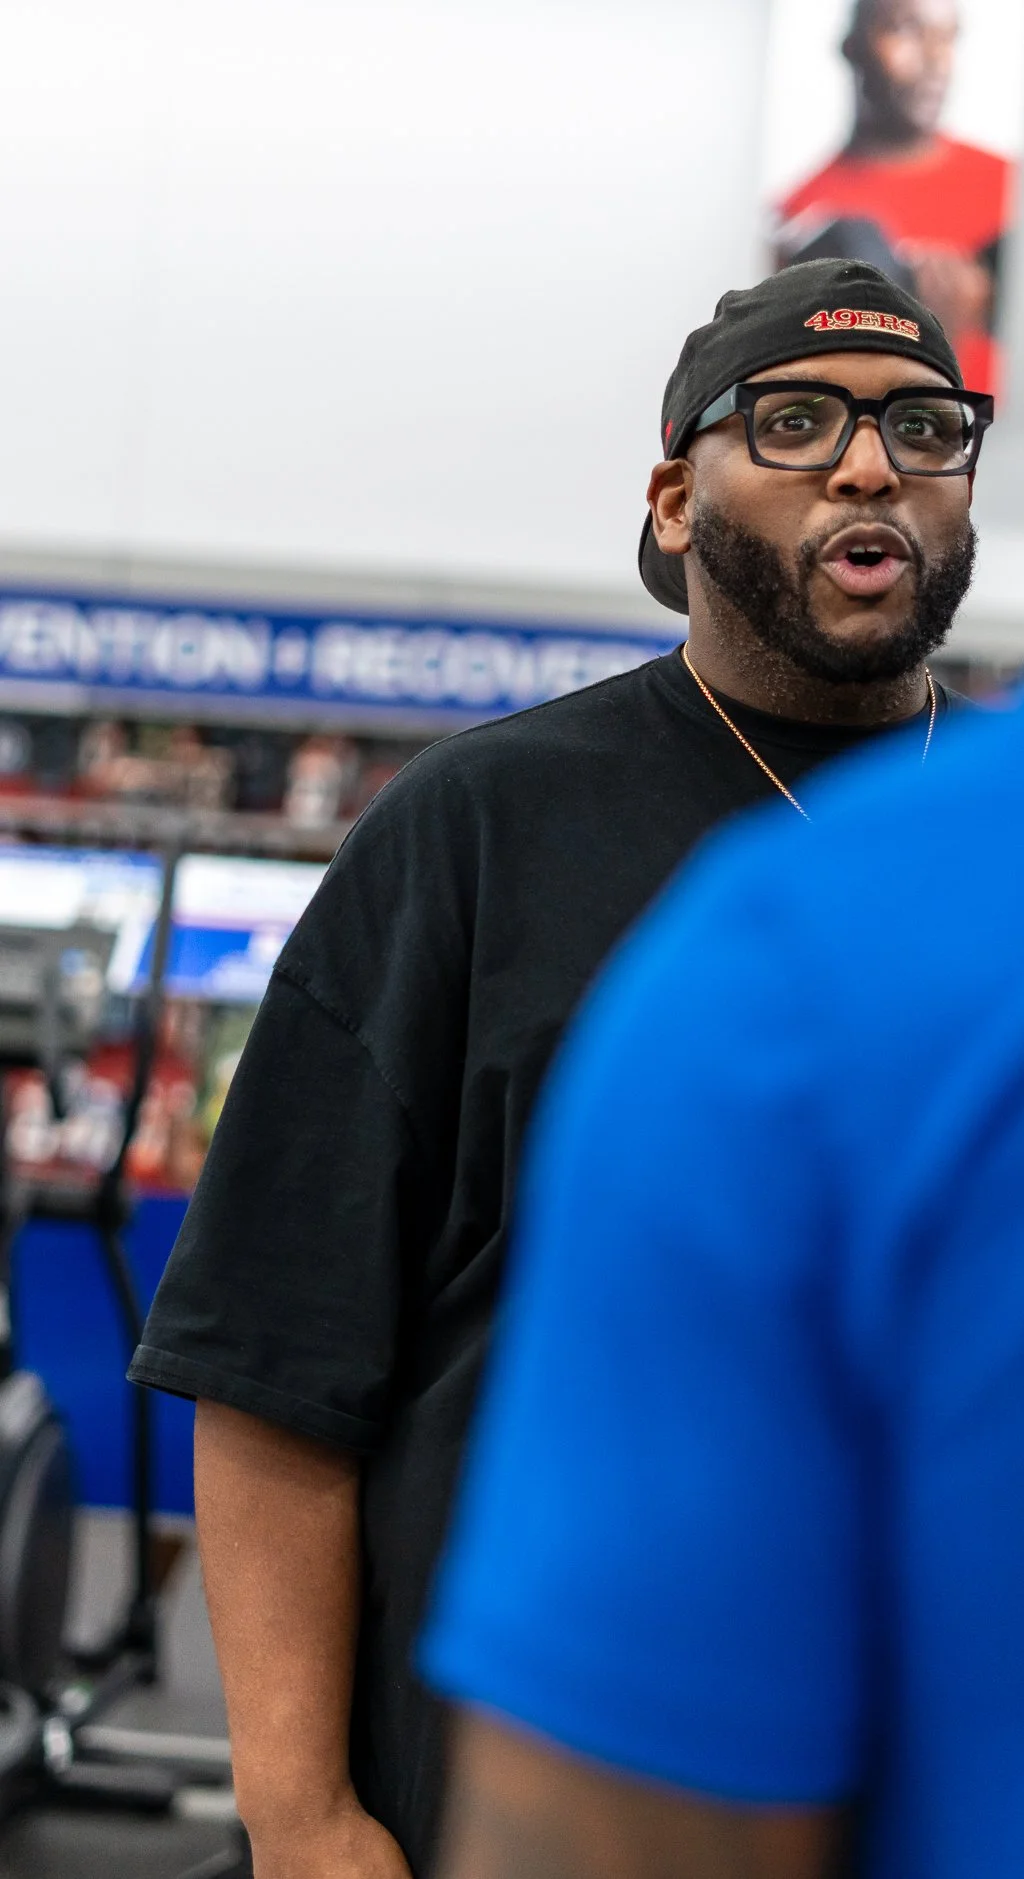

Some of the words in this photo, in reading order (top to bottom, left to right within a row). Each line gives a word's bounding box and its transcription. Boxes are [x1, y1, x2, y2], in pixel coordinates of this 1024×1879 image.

[804, 308, 920, 338] 49ERS
[0, 601, 271, 688] ENTION
[313, 622, 658, 706] RECOVER
